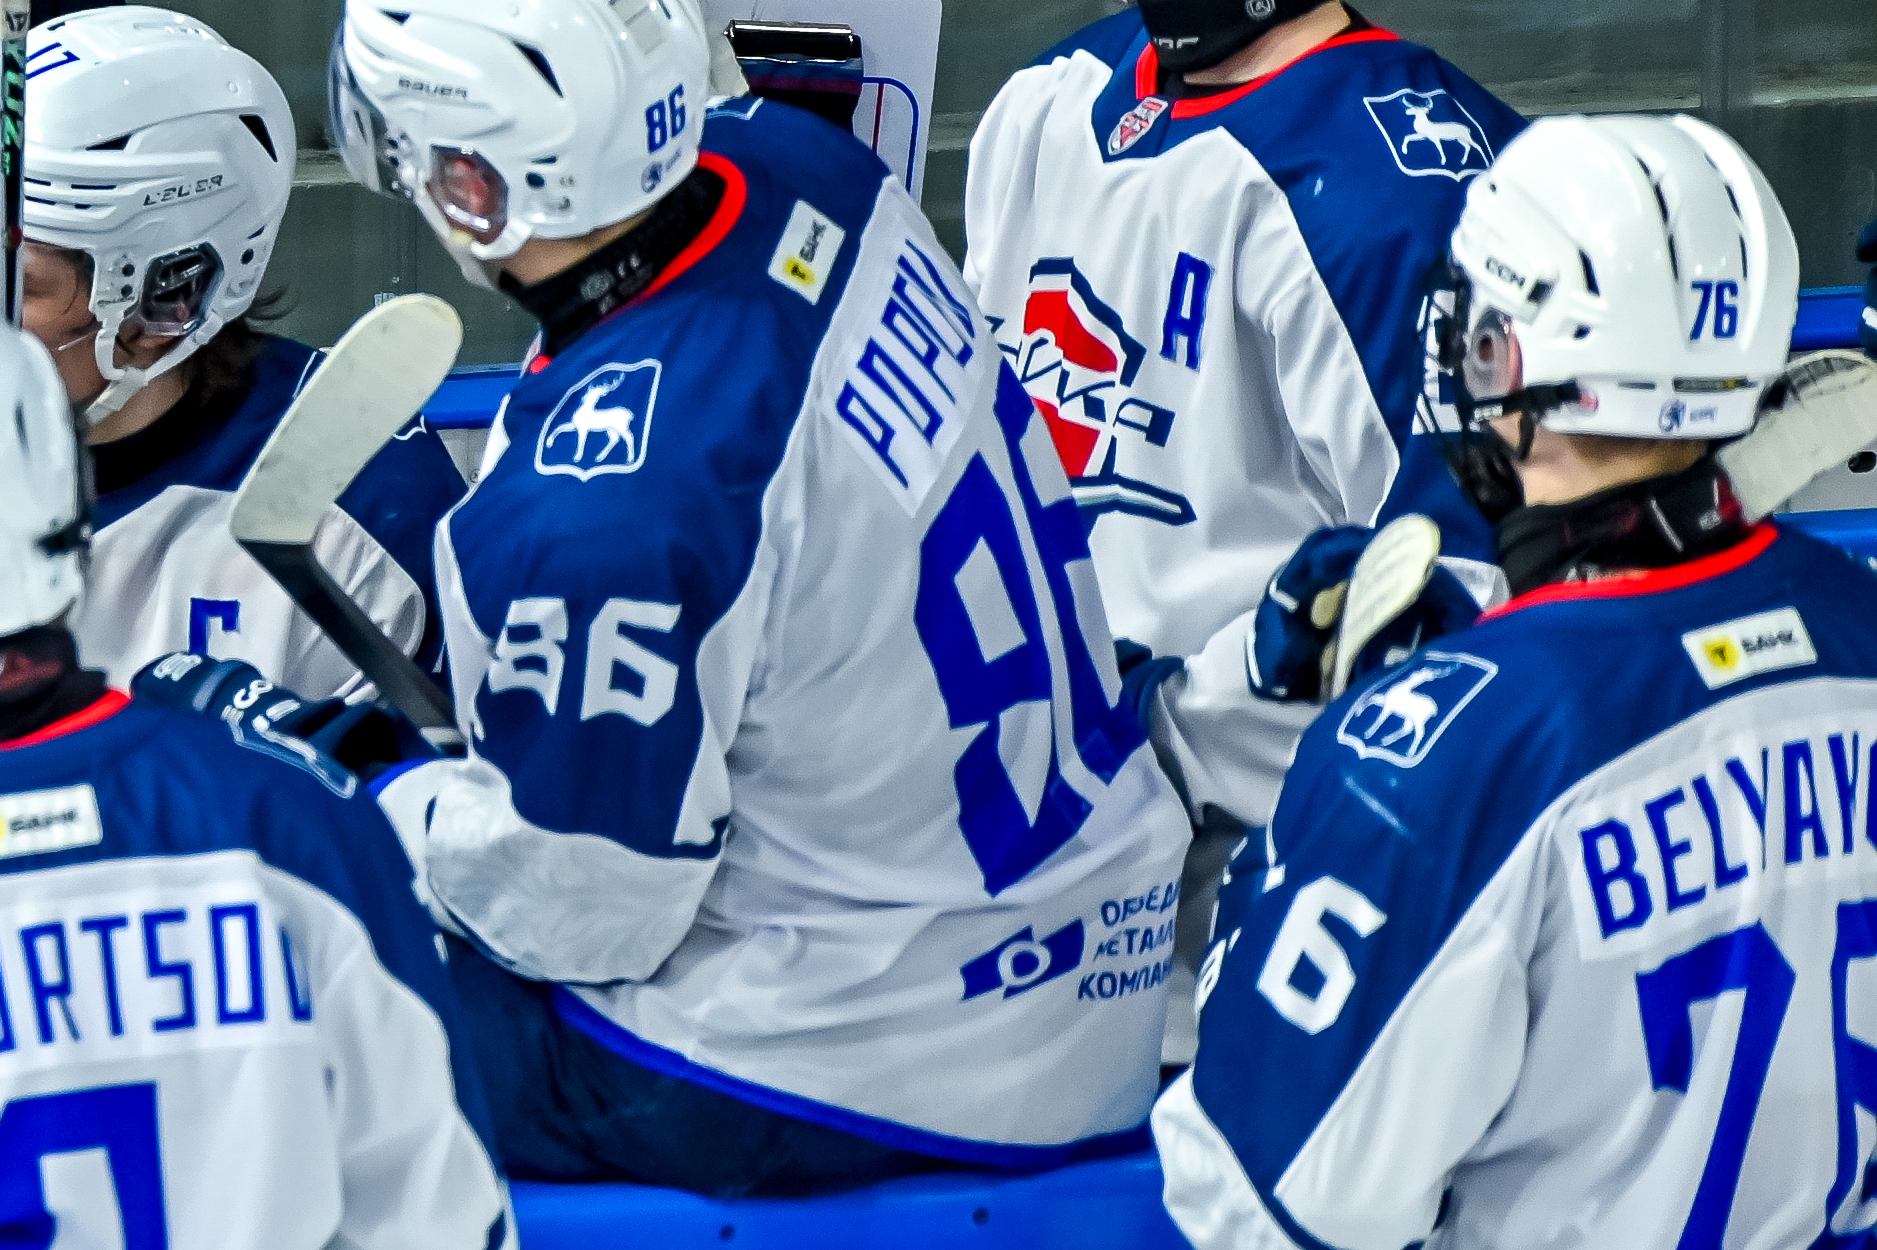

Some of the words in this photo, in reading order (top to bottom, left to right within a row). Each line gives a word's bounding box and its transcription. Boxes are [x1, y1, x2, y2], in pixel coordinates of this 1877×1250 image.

[645, 82, 686, 154] 86
[1160, 251, 1211, 372] A
[1689, 280, 1738, 340] 76
[488, 596, 683, 727] 86
[1579, 730, 1877, 940] BELYAY
[1255, 875, 1388, 1036] 6
